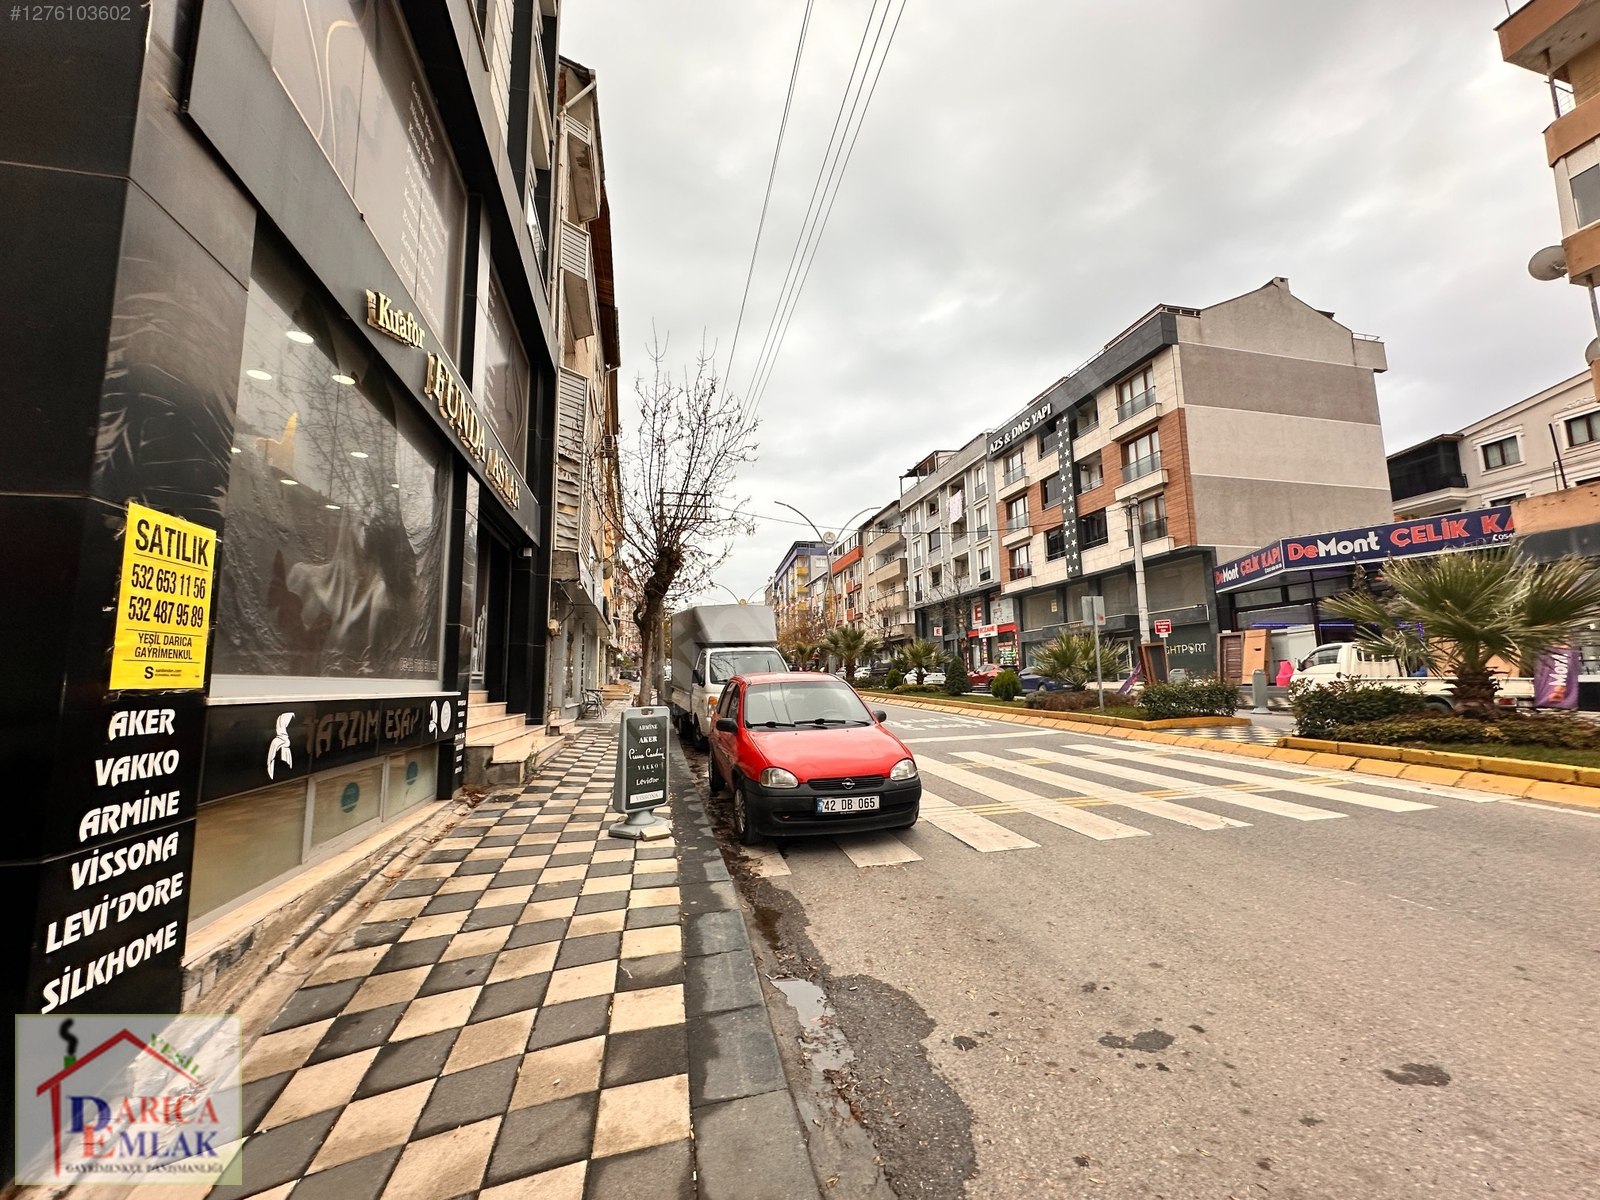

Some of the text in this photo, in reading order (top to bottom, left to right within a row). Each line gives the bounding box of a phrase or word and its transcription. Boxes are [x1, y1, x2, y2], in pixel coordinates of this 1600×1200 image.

[424, 351, 486, 463] FUNDA
[989, 402, 1051, 455] AZS & DMS YAPI
[135, 518, 210, 567] SATILIK
[1287, 531, 1381, 561] DeMont
[1389, 517, 1471, 548] ÇELİK
[131, 563, 206, 600] 532 653 11 56
[128, 595, 204, 629] 532 487 95 89
[134, 646, 193, 660] GAYRİMENKUL
[138, 632, 192, 648] YEŞİL DARICA
[108, 708, 176, 742] AKER
[638, 735, 658, 744] AKER
[95, 749, 180, 788] VAKKO
[78, 789, 181, 843] ARMİNE
[824, 797, 875, 811] 42 DB 065
[71, 831, 179, 891] VİSSONA
[45, 871, 184, 954] LEVİ'DORE
[41, 920, 178, 1015] SİLKHOME
